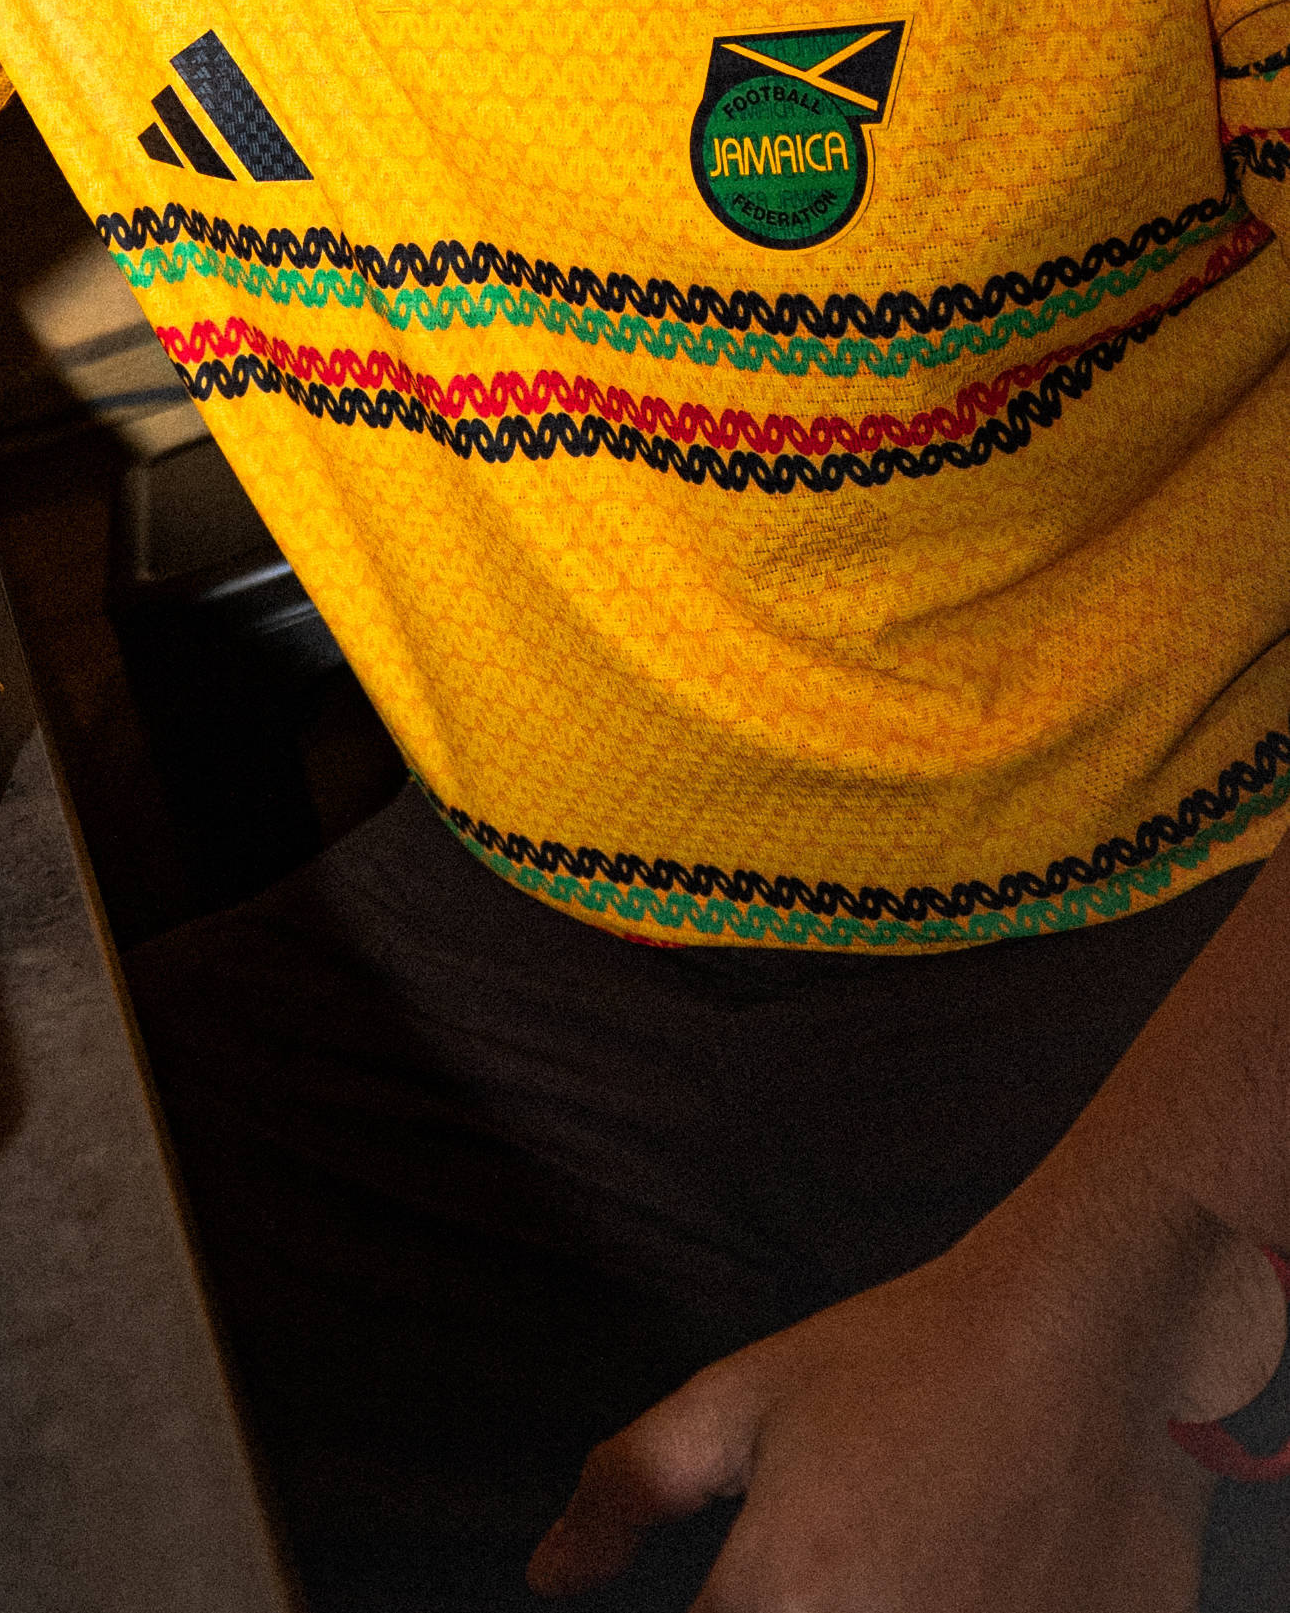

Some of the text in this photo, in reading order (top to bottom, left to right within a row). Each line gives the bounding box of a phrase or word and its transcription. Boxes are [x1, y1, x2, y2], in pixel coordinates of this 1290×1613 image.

[722, 85, 822, 120] FOOTBALL
[710, 131, 849, 177] JAMAICA
[732, 190, 838, 228] FEDERATION
